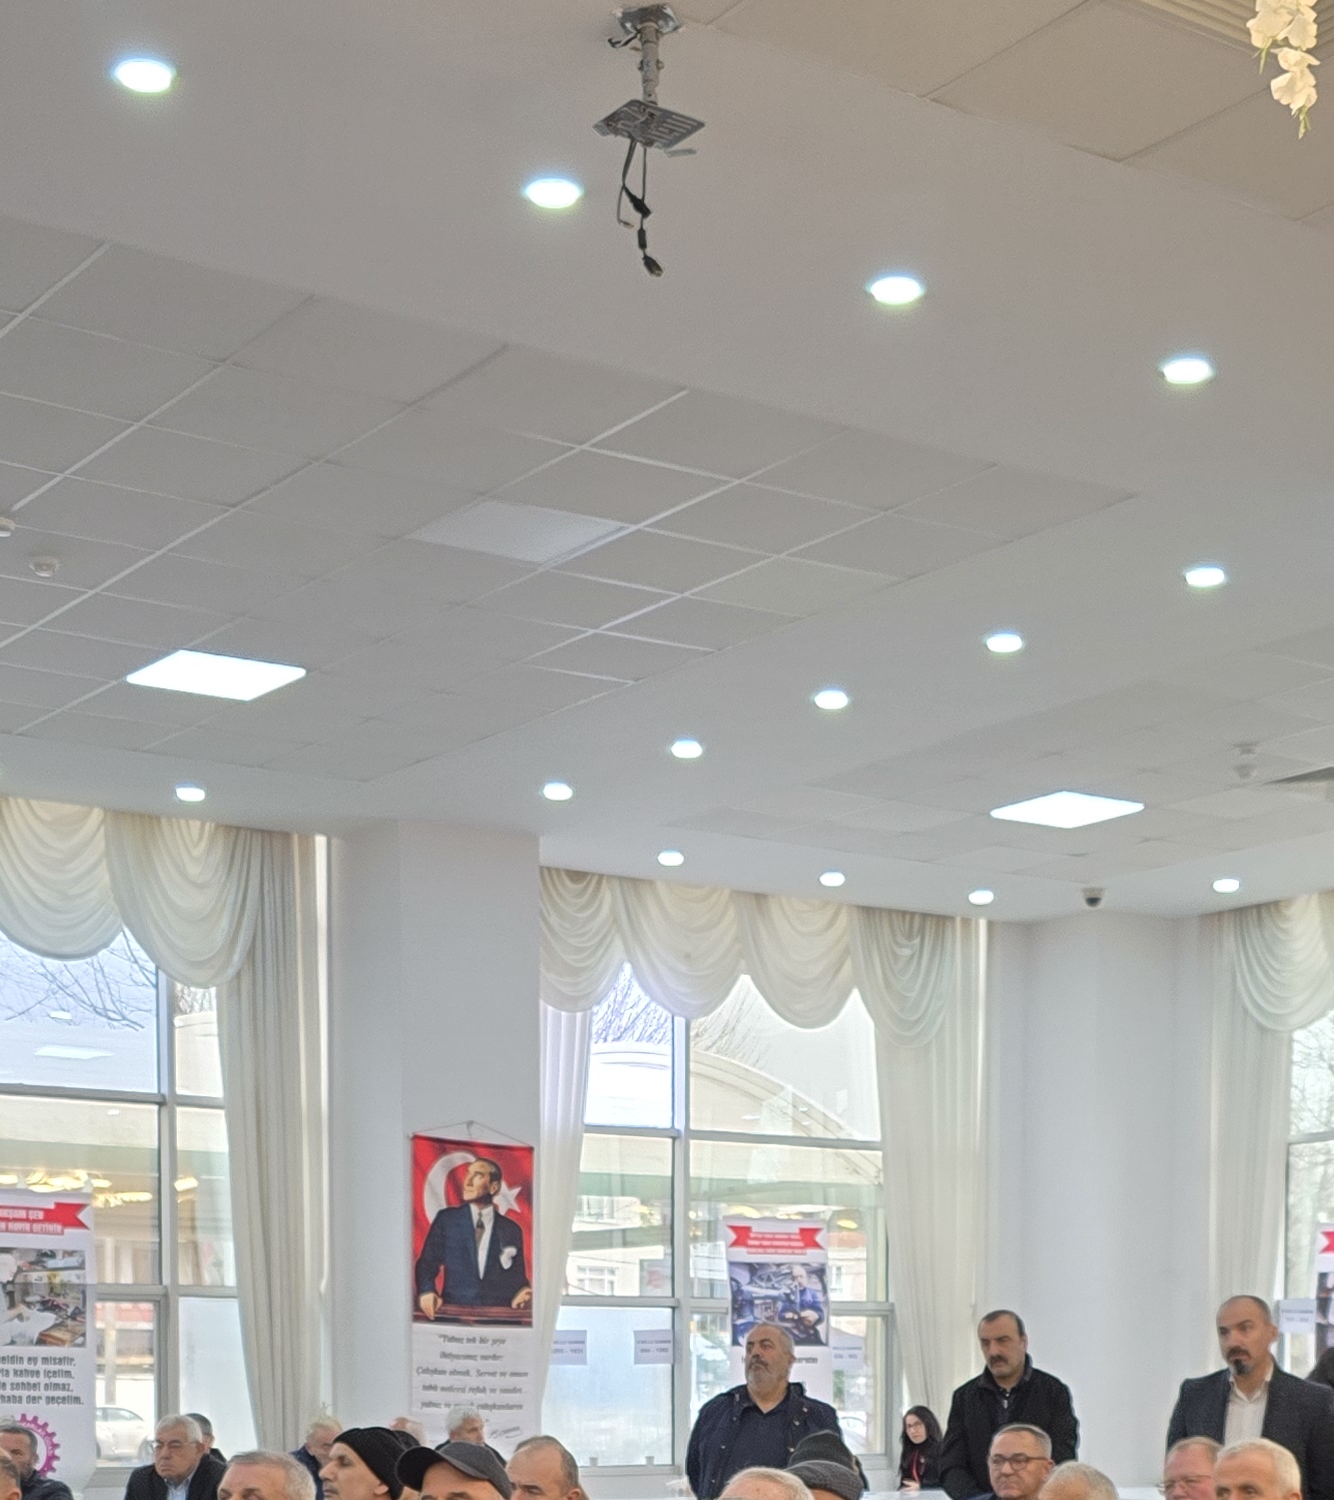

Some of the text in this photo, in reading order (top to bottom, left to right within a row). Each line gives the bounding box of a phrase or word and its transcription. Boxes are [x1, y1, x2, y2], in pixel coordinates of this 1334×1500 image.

[27, 1356, 39, 1367] ey
[13, 1368, 41, 1379] kahve
[9, 1381, 41, 1392] sohbet
[25, 1394, 43, 1405] der
